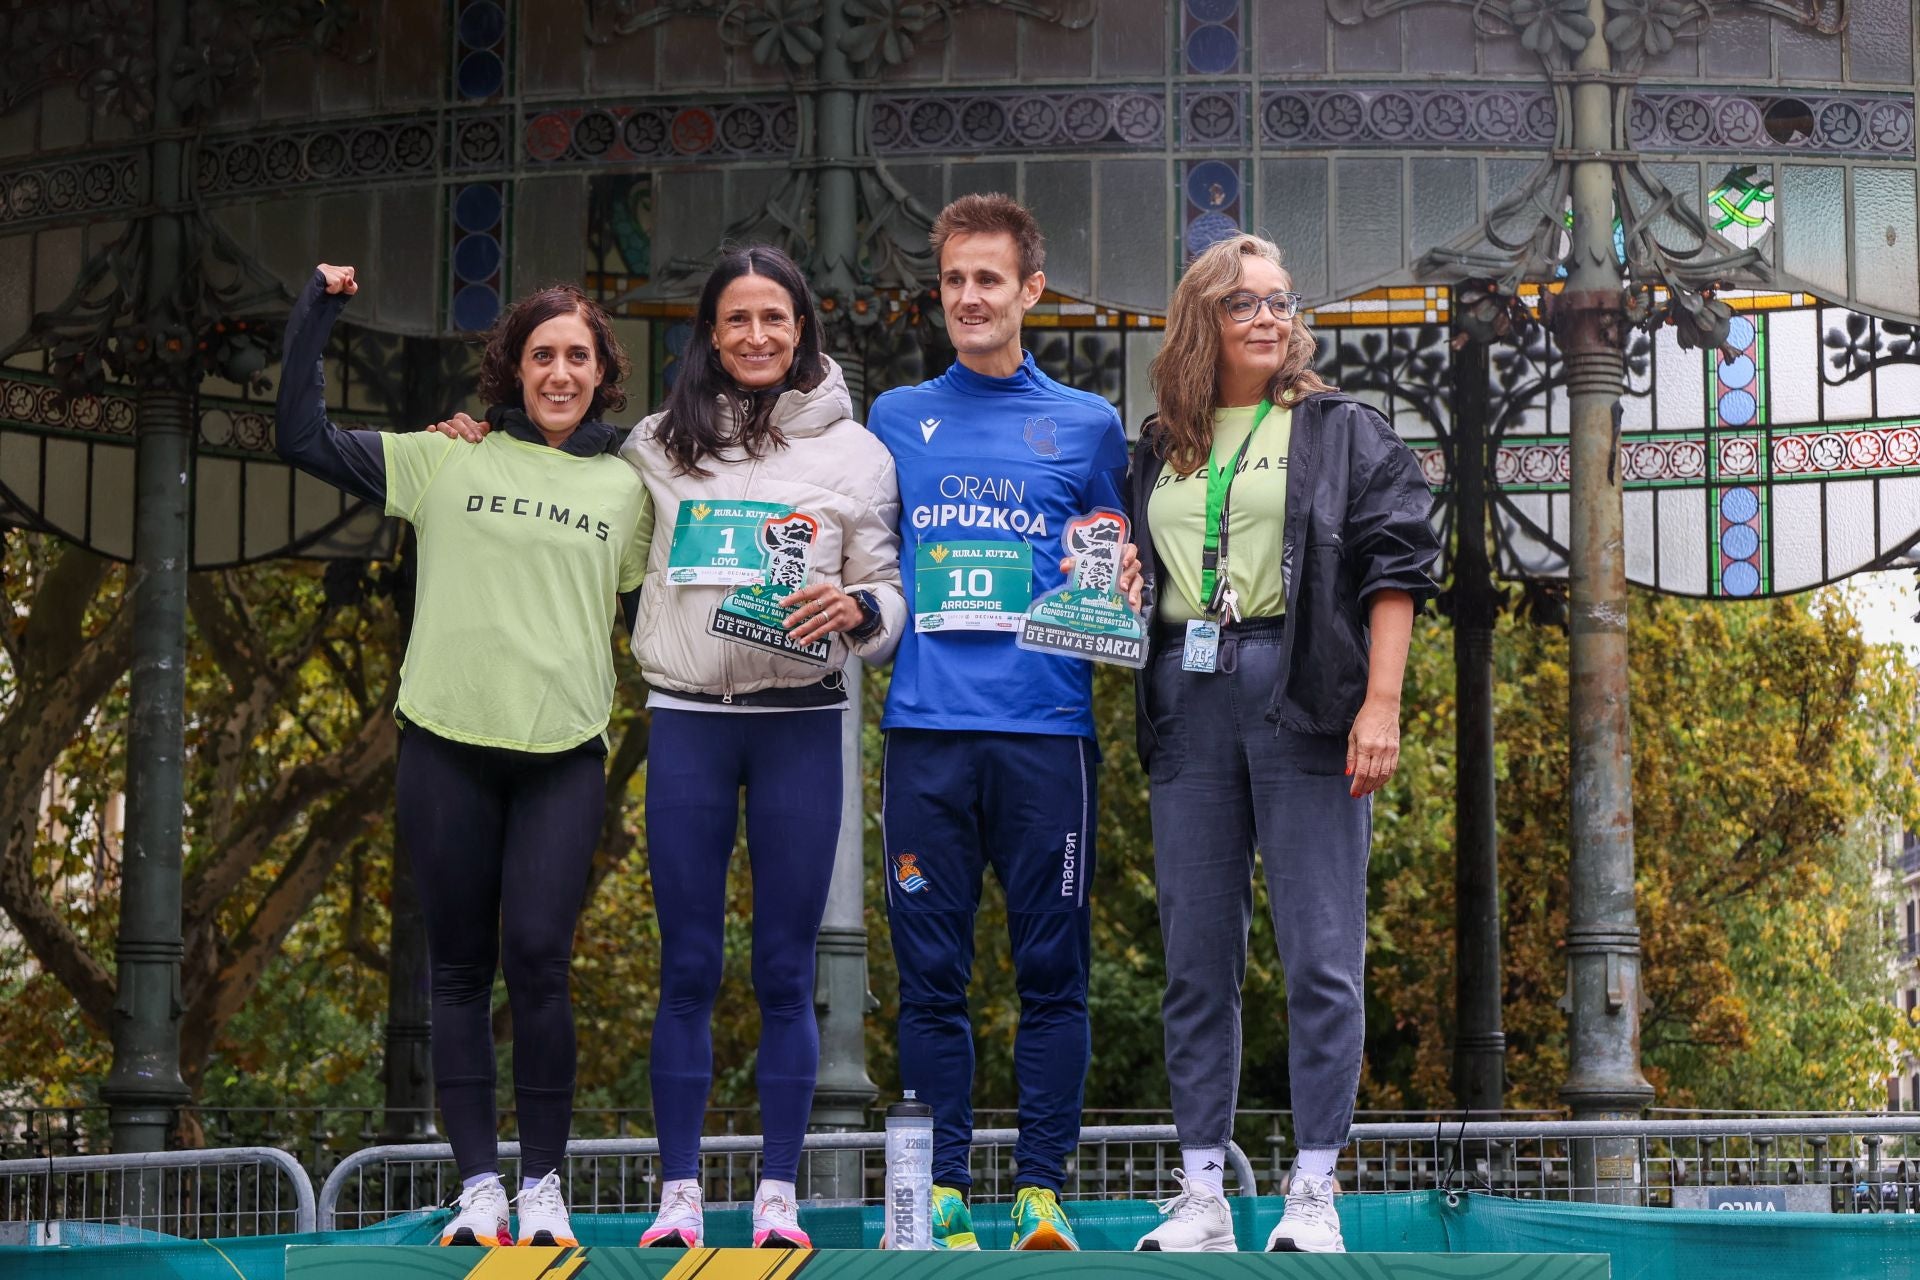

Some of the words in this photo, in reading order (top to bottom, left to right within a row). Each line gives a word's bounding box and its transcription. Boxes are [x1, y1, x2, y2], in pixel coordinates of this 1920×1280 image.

[940, 475, 1025, 503] ORAIN
[466, 495, 610, 542] DECIMAS
[713, 508, 743, 517] RURAL
[912, 504, 1047, 537] GIPUZKOA
[717, 527, 736, 555] 1
[711, 557, 739, 566] LOYO
[952, 549, 983, 558] RURAL
[985, 550, 1019, 559] KUTXA
[948, 568, 993, 597] 10
[733, 598, 765, 612] DONOSTIA
[770, 608, 784, 618] SAN
[941, 600, 1002, 610] ARROSPIDE
[1042, 607, 1075, 619] DONOSTIA
[1081, 613, 1095, 622] SAN
[718, 613, 735, 623] EUSKAL
[1027, 624, 1045, 632] EUSKAL
[716, 619, 783, 646] DECIMAS
[1025, 630, 1093, 651] DECIMAS
[1095, 636, 1140, 659] SARIA
[1188, 647, 1215, 664] VIP
[1061, 832, 1077, 897] macron
[895, 1187, 914, 1244] 226ERS
